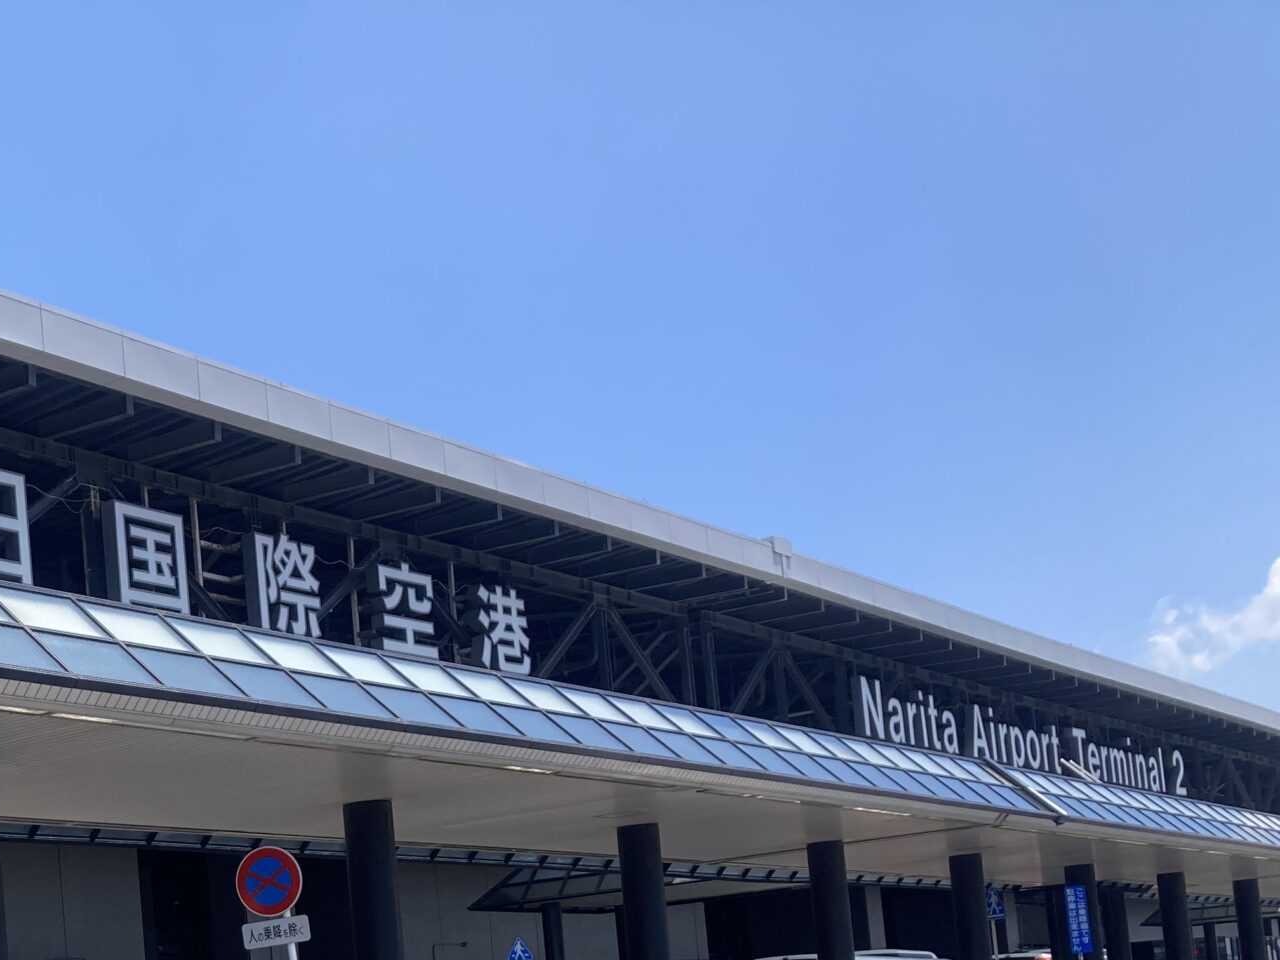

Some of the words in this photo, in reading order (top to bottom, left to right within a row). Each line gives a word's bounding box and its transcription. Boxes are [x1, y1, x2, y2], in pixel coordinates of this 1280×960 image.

[860, 675, 960, 754] Narita
[973, 703, 1062, 775] Airport
[1072, 727, 1166, 793] Terminal
[1172, 749, 1188, 796] 2
[249, 922, 305, 944] 人の乗降を除く
